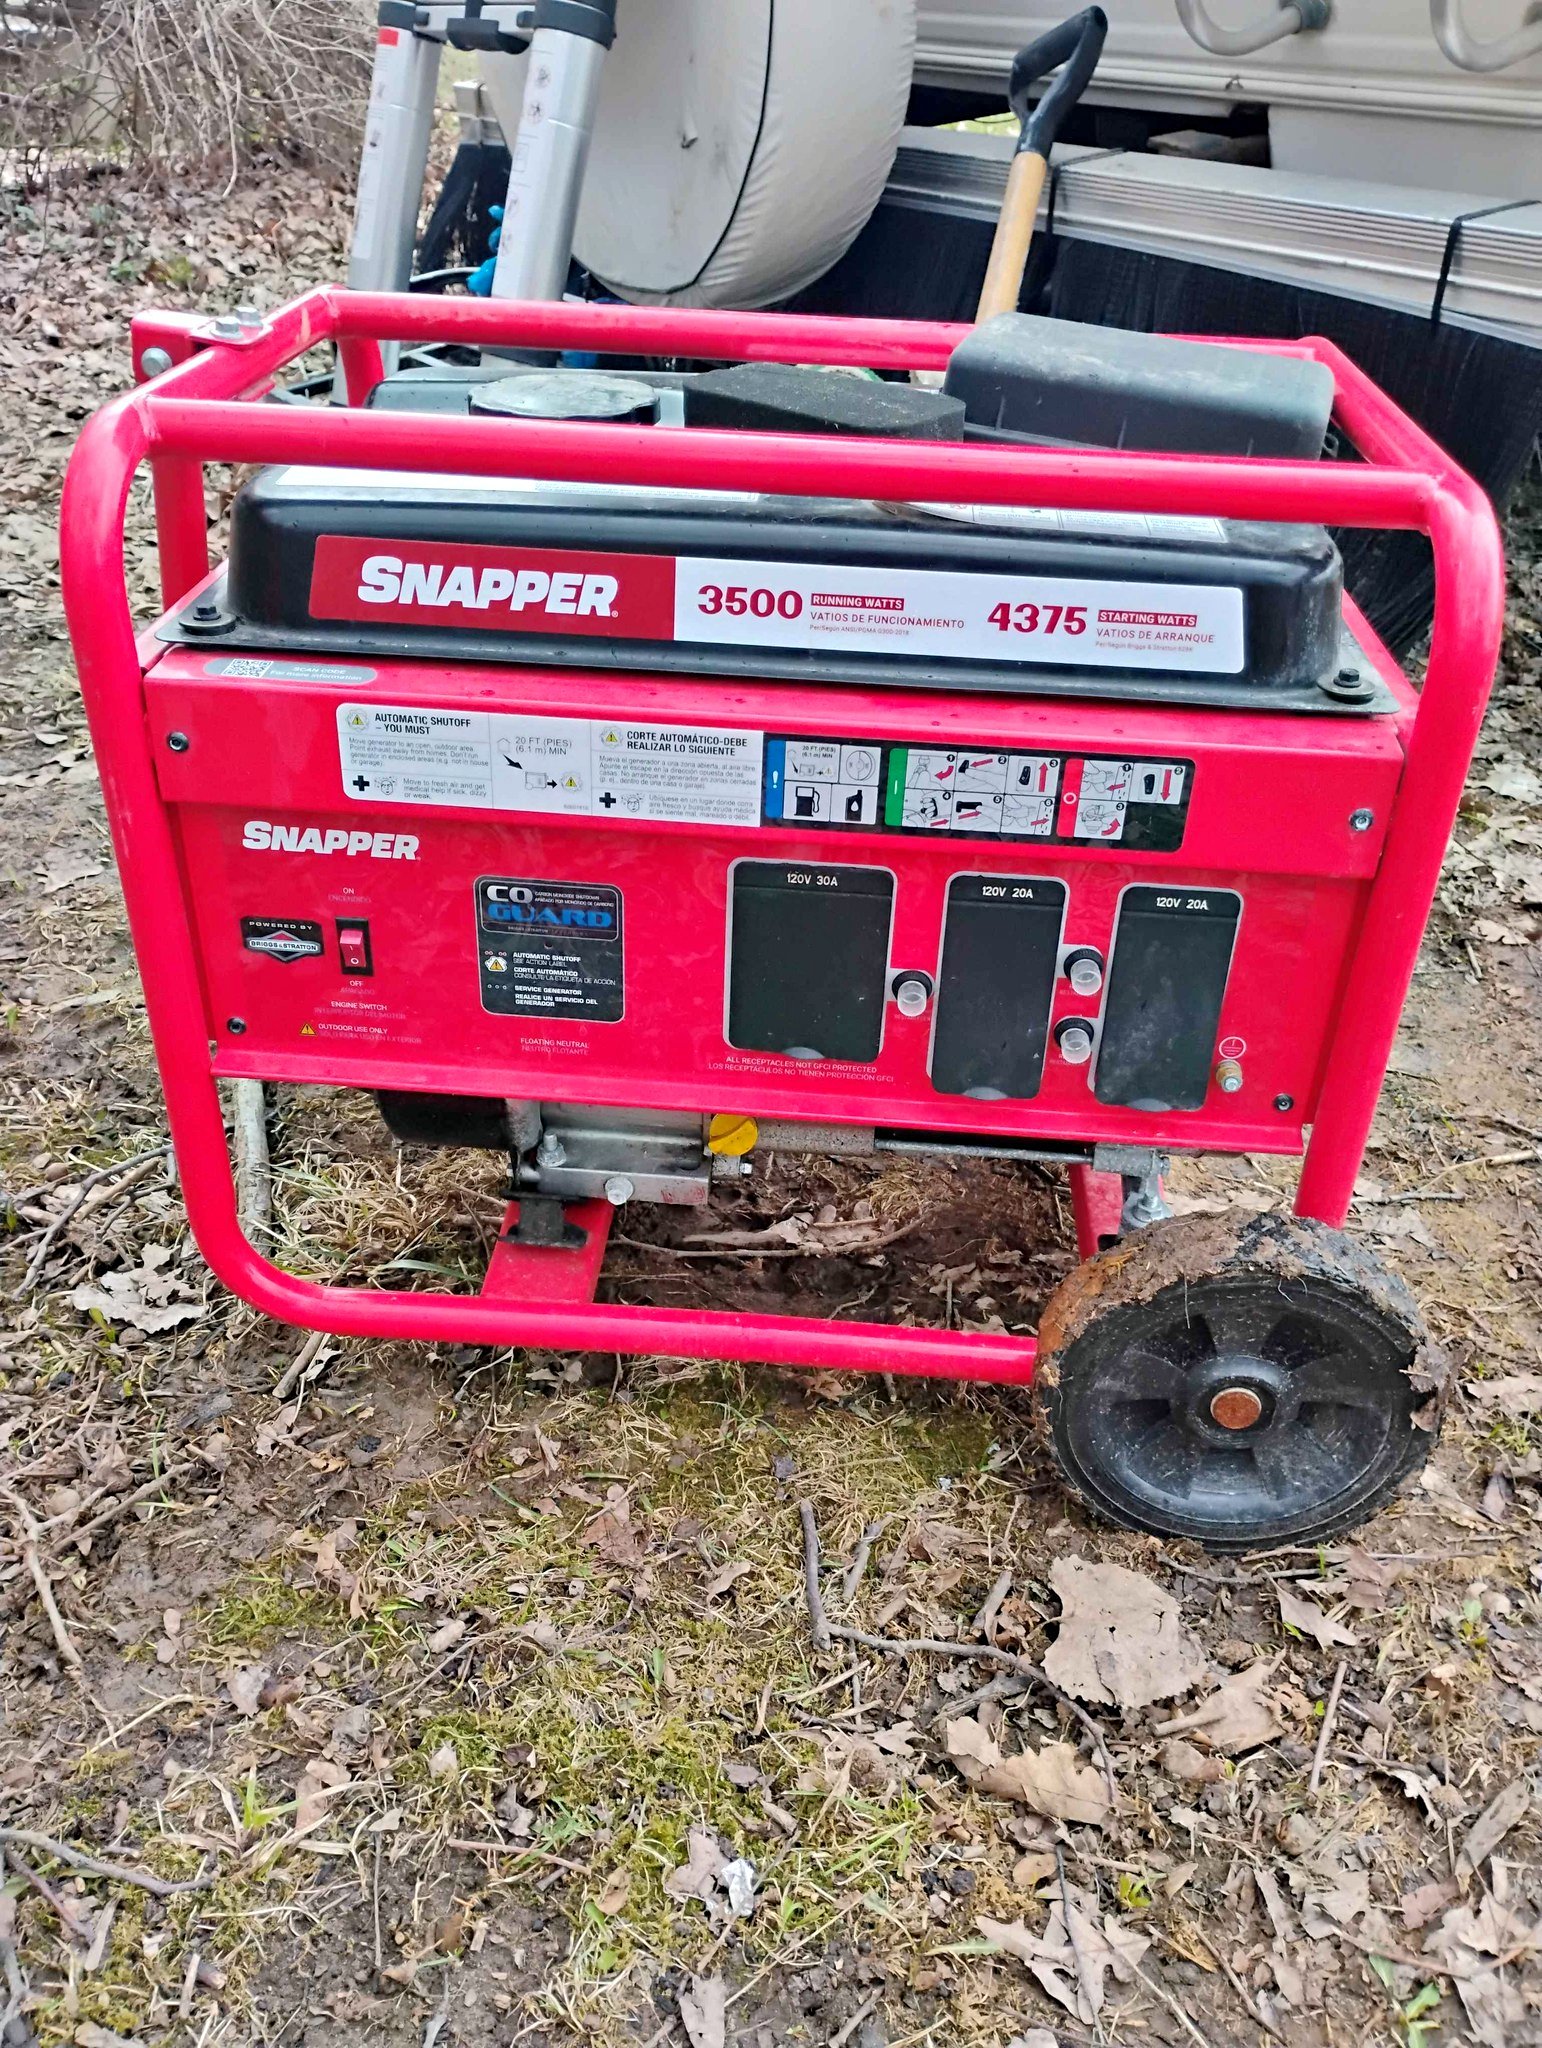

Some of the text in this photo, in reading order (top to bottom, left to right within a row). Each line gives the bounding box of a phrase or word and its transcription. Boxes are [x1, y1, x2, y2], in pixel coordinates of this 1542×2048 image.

[357, 555, 618, 618] SNAPPER
[698, 585, 803, 619] 3500
[812, 595, 903, 610] RUNNING WATTS
[810, 612, 965, 629] VATIOS DE FUNCIONAMIENTO
[987, 602, 1088, 635] 4375
[1100, 611, 1196, 627] STARTING WATTS
[1096, 628, 1215, 644] VATIOS DE ARRANQUE
[375, 713, 470, 727] AUTOMATIC SHUTOFF
[384, 724, 402, 732] YOU
[405, 726, 430, 734] MUST
[544, 738, 571, 747] (PIES)
[627, 731, 747, 747] CORTE AUTOMÁTICO-DEBE
[535, 747, 546, 755] m)
[550, 747, 566, 755] MIN
[627, 741, 735, 756] REALIZAR LO SIGUIENTE
[242, 821, 419, 860] SNAPPER
[787, 873, 838, 886] 120V 30A
[487, 885, 533, 903] CO
[982, 886, 1033, 898] 120V 20A
[1156, 897, 1208, 910] 120V 20A
[488, 902, 612, 927] GUARD
[283, 943, 316, 951] STRATTON
[513, 952, 550, 960] AUTOMATIC
[537, 968, 578, 976] AUTOMÁTICO
[330, 1001, 358, 1009] ENGINE
[319, 1023, 353, 1031] OUTDOOR
[354, 1025, 368, 1033] USE
[520, 1037, 589, 1048] FLOATING NEUTRAL
[742, 1058, 794, 1068] RECEPTACLES
[832, 1064, 877, 1073] PROTECTED
